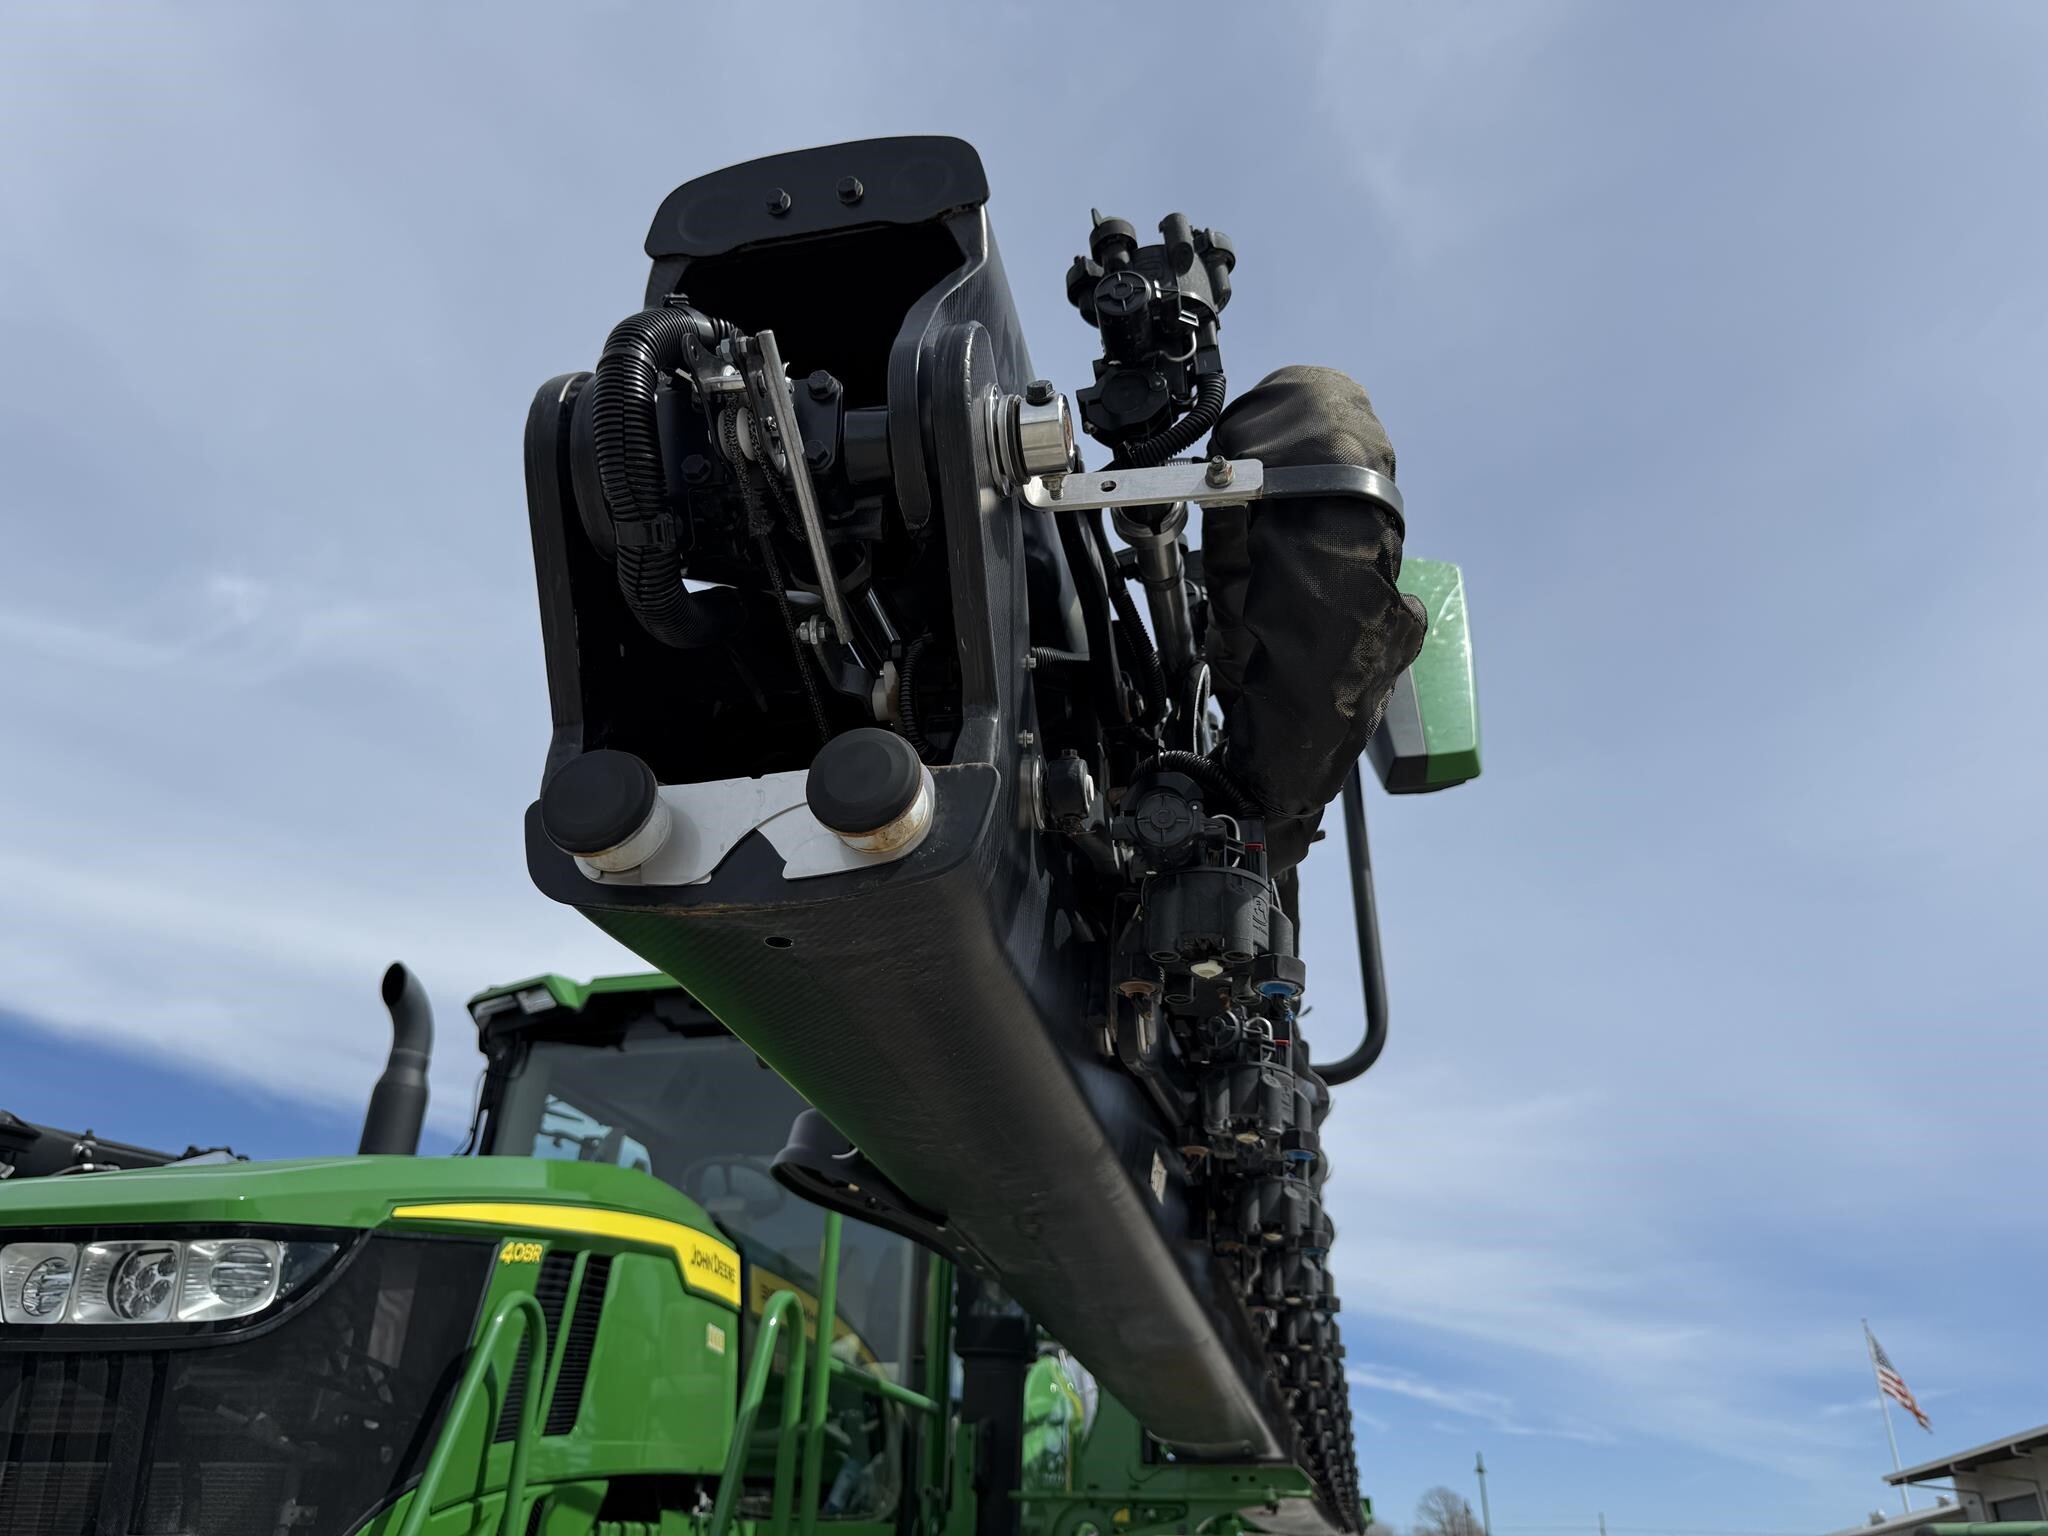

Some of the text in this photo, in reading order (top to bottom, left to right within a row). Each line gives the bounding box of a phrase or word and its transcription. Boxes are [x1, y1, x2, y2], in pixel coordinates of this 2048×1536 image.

[499, 1241, 543, 1264] 408R
[691, 1244, 737, 1284] JOHN DEERE
